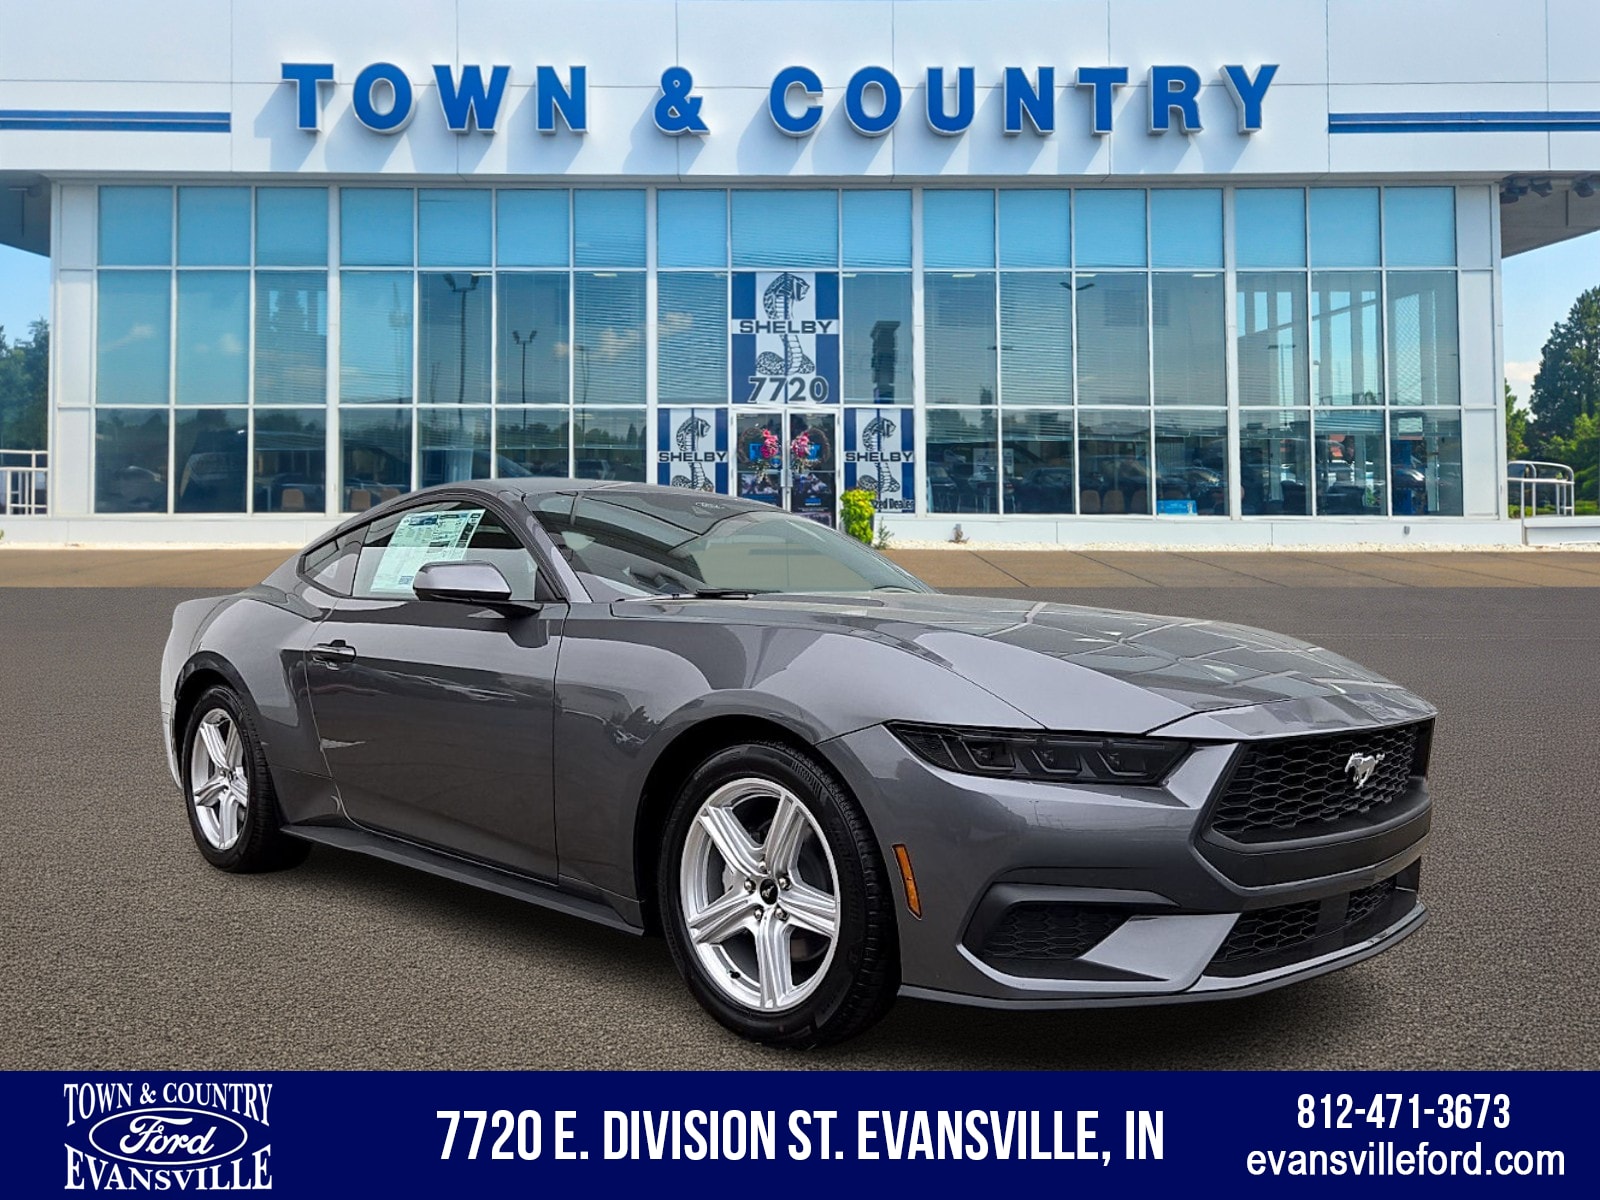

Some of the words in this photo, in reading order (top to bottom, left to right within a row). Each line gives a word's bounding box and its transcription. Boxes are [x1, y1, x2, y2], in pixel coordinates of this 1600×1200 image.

[281, 63, 587, 134] TOWN
[655, 67, 709, 135] &
[769, 65, 1279, 135] COUNTRY
[739, 320, 832, 334] SHELBY
[749, 377, 828, 402] 7720
[658, 452, 728, 462] SHELBY
[845, 452, 914, 462] SHELBY
[889, 498, 914, 509] Dealer
